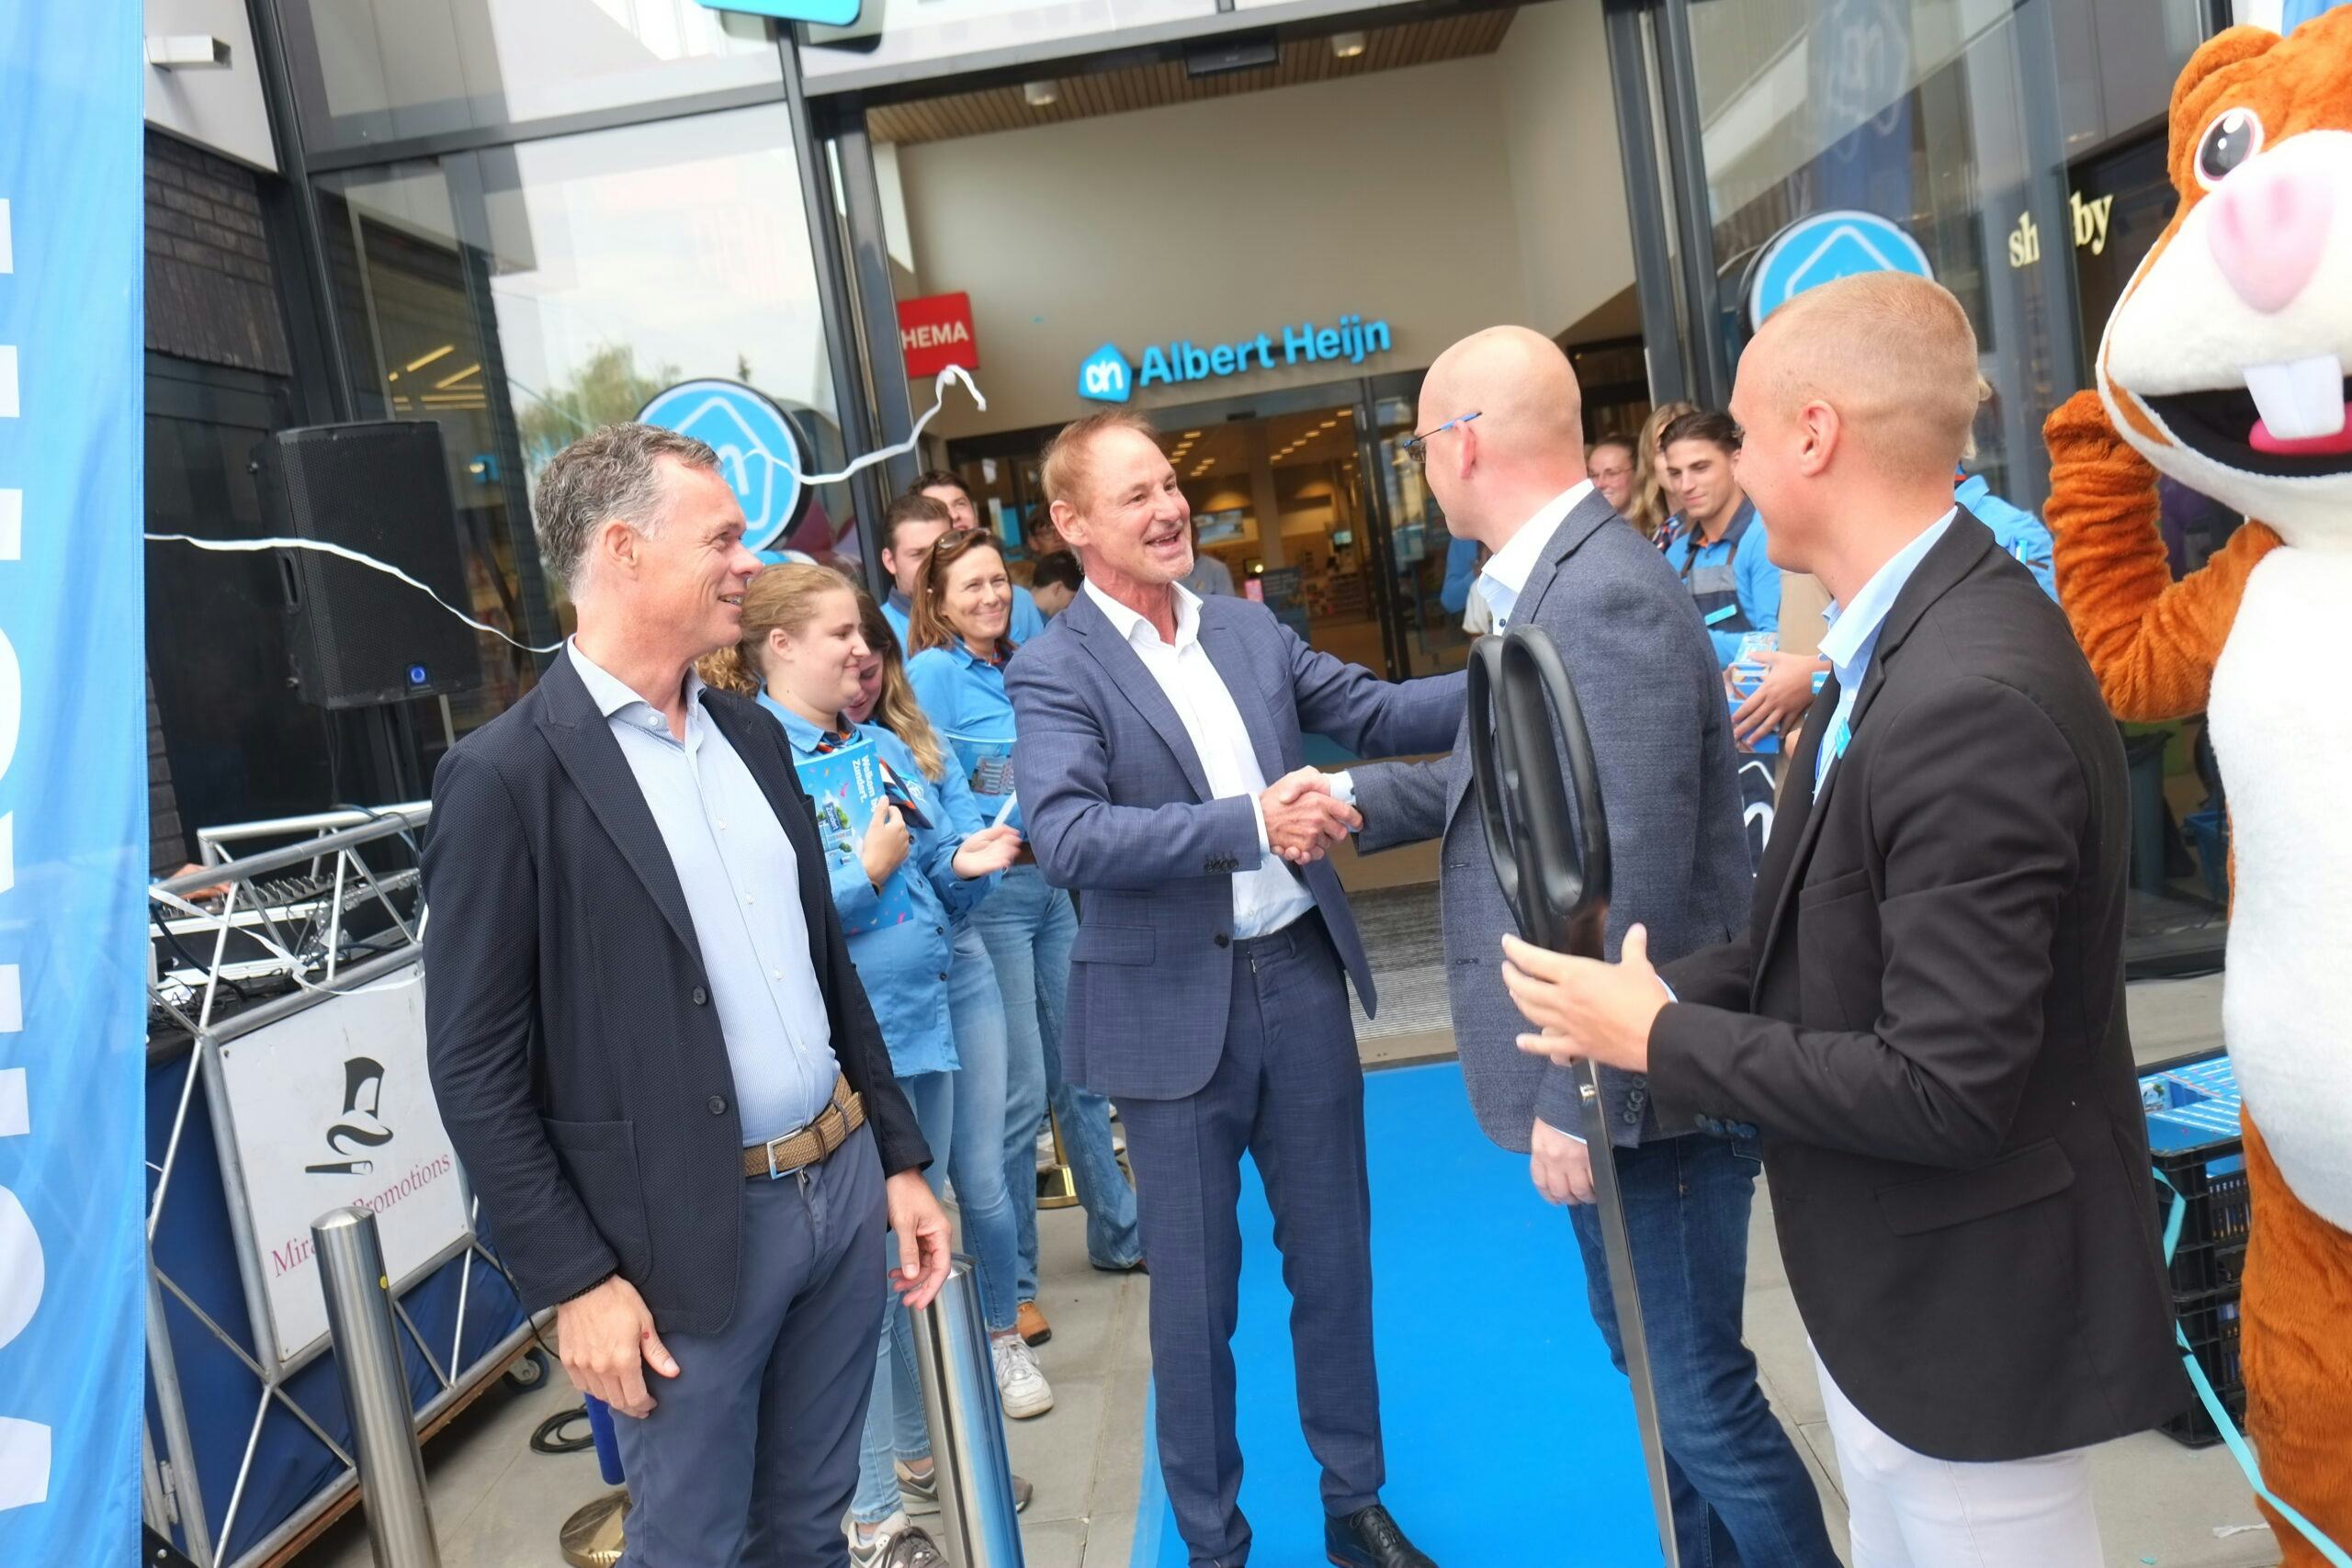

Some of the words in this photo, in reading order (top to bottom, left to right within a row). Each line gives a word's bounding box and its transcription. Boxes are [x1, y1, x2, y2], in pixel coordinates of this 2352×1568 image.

[2008, 190, 2113, 267] shby
[900, 321, 969, 350] HEMA
[1139, 333, 1276, 388] Albert
[1283, 314, 1392, 365] Heijn
